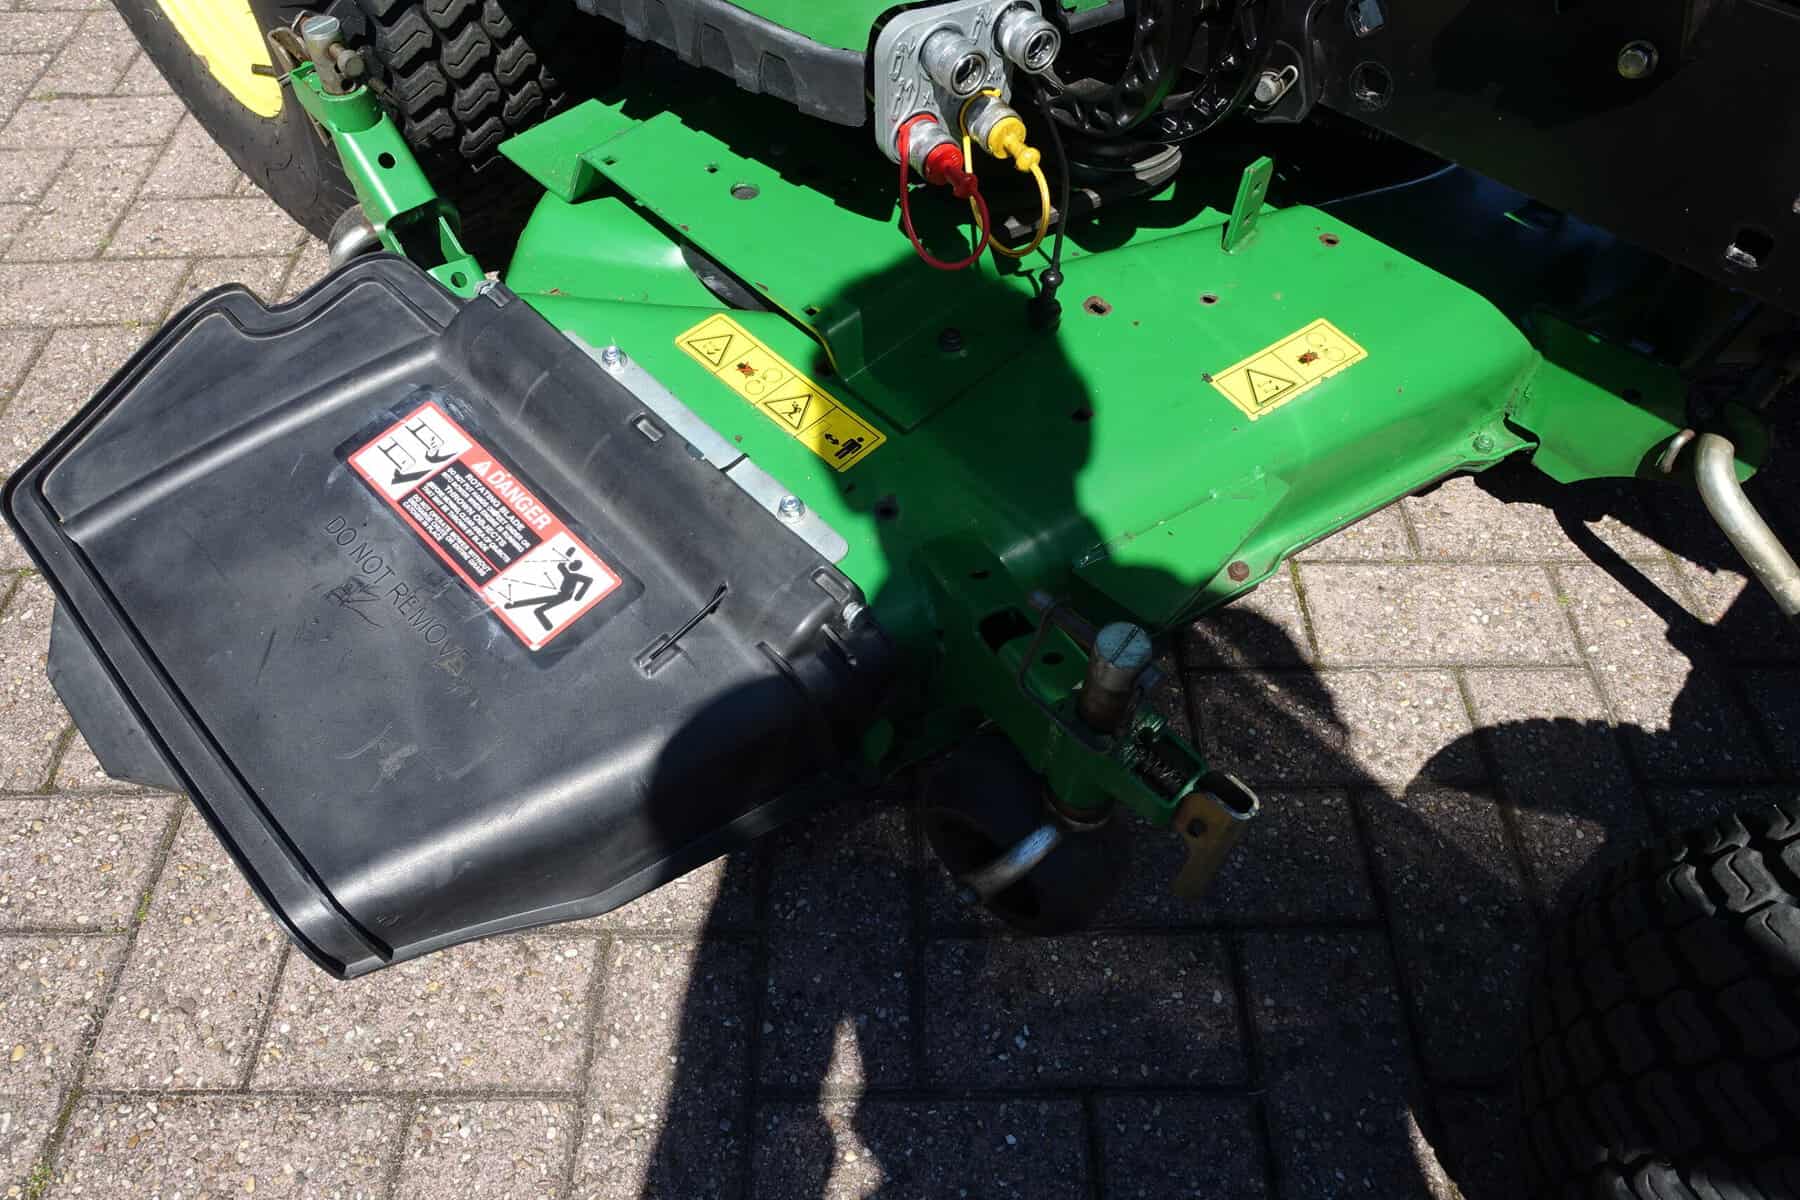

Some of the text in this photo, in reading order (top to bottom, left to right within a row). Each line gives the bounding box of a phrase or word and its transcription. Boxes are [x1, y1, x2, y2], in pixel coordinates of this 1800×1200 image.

[442, 484, 508, 547] THROWN OBJECTS
[463, 472, 526, 531] ROTATING BLADE
[487, 470, 552, 531] DANGER
[325, 515, 358, 547] DO
[350, 541, 396, 585] NOT
